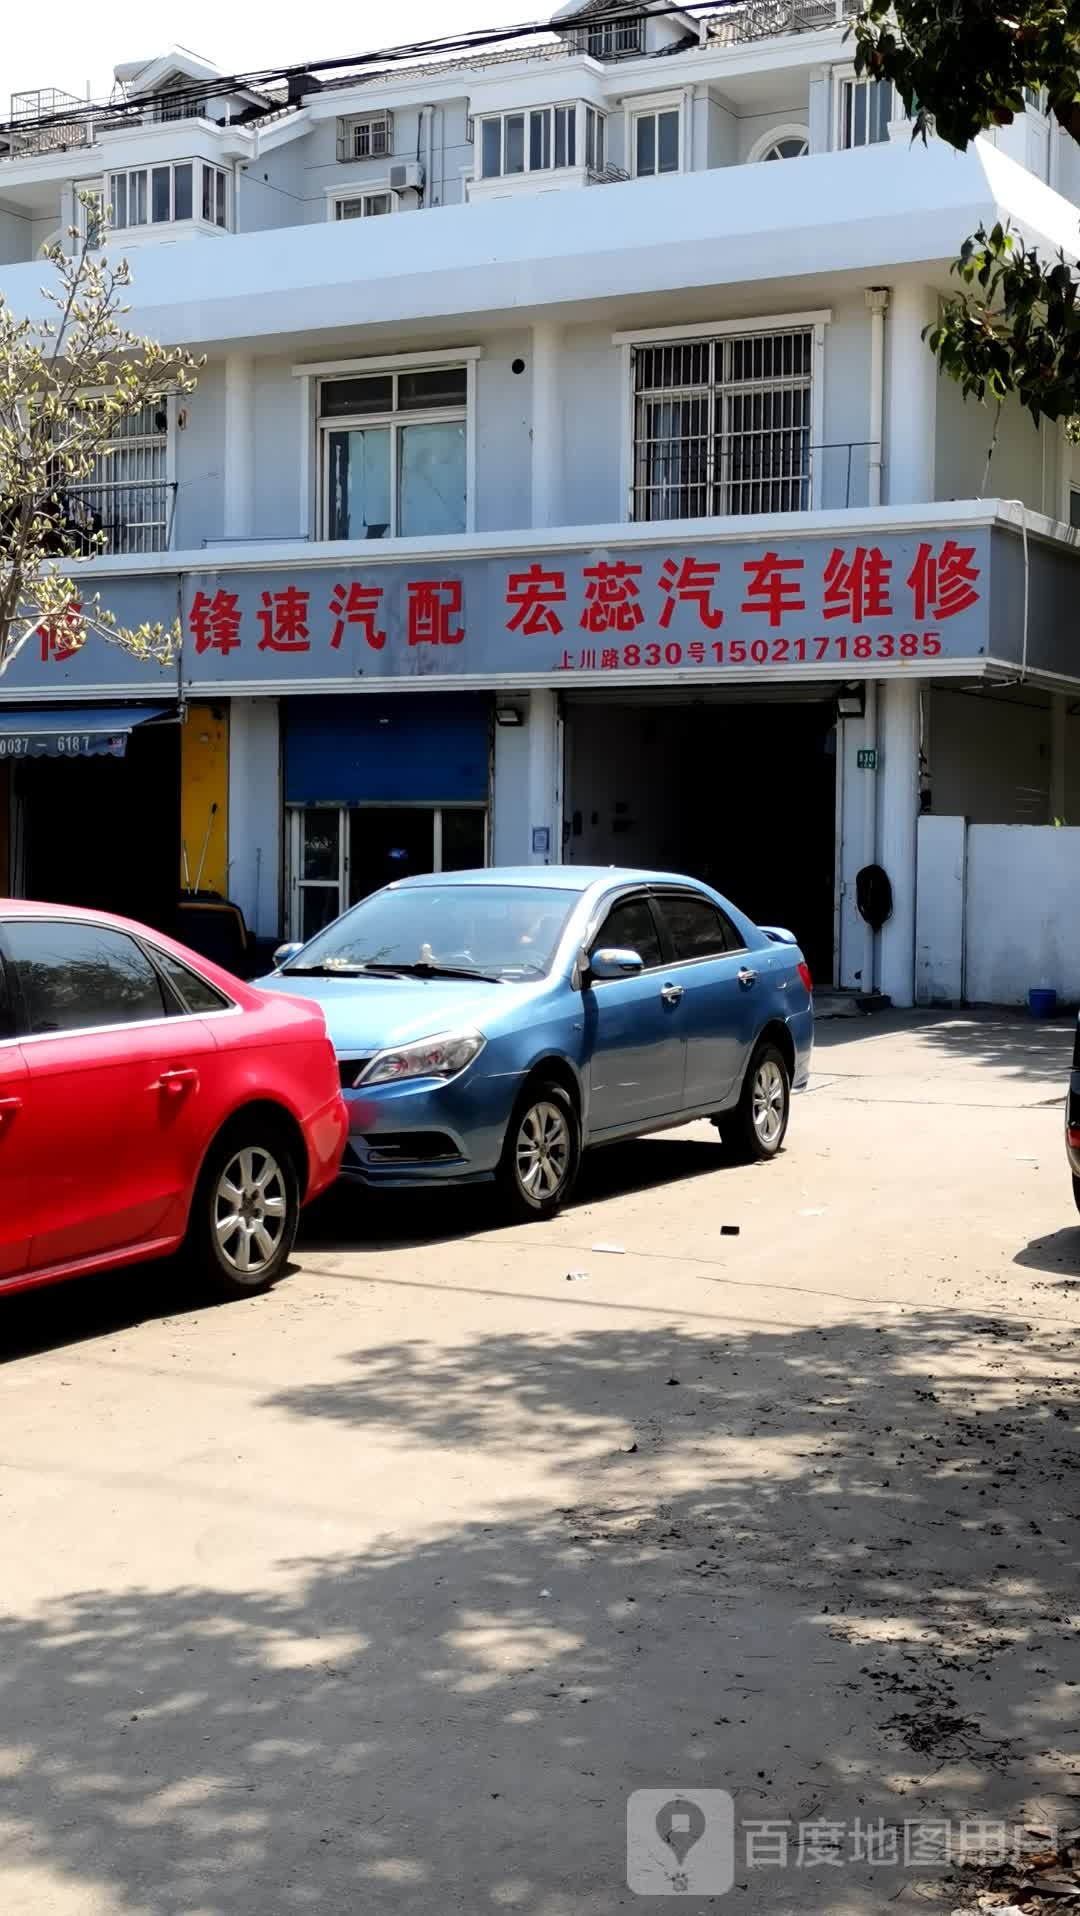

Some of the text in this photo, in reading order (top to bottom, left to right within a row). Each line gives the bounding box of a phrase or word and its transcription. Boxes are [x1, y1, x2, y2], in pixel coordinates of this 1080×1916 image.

[188, 540, 981, 656] 锋速汽配 宏蕊汽车维修
